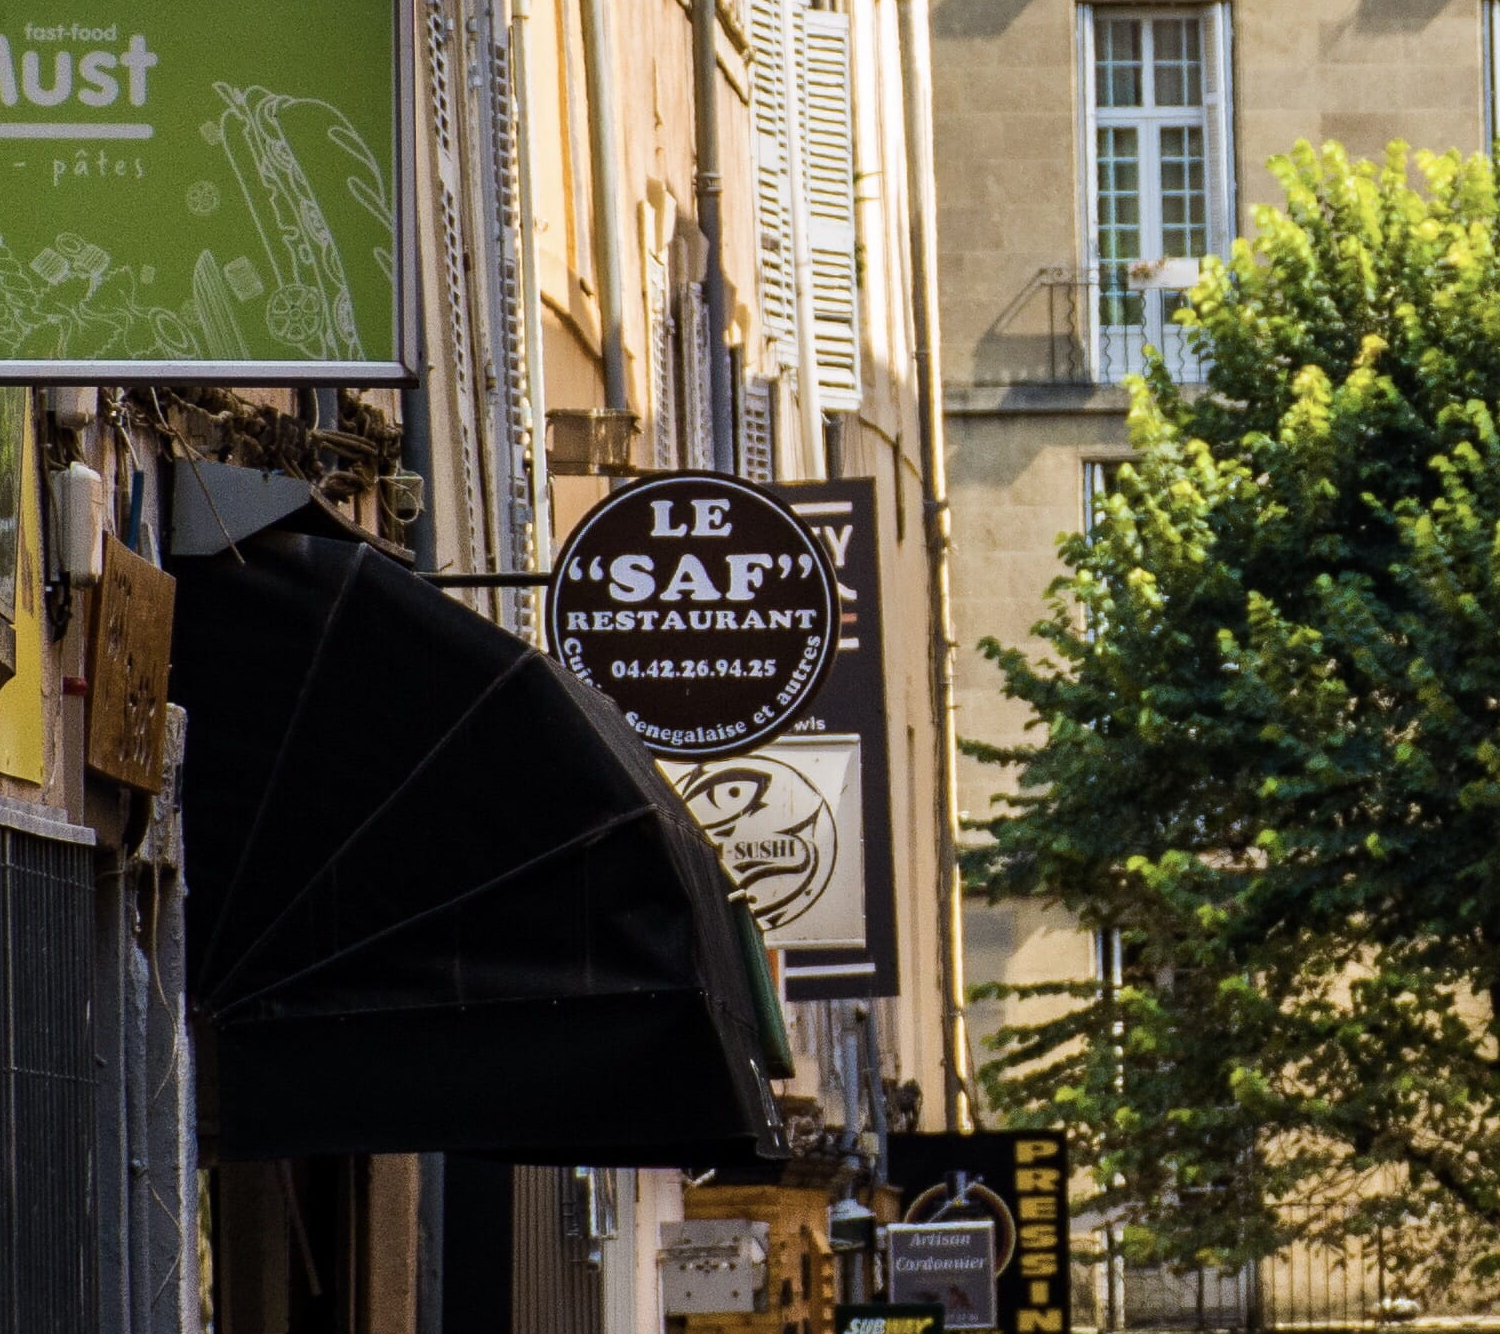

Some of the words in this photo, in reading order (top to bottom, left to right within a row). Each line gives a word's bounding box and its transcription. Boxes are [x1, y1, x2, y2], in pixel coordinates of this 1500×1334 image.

[24, 22, 118, 42] fast-food
[52, 148, 146, 186] pâtes
[649, 499, 733, 538] LE
[566, 609, 818, 632] RESTAURANT
[610, 658, 778, 680] 04.42.26.94.25
[753, 704, 776, 725] et
[775, 634, 822, 706] autres
[908, 1231, 972, 1246] Artisan
[894, 1255, 986, 1271] Cordonnier
